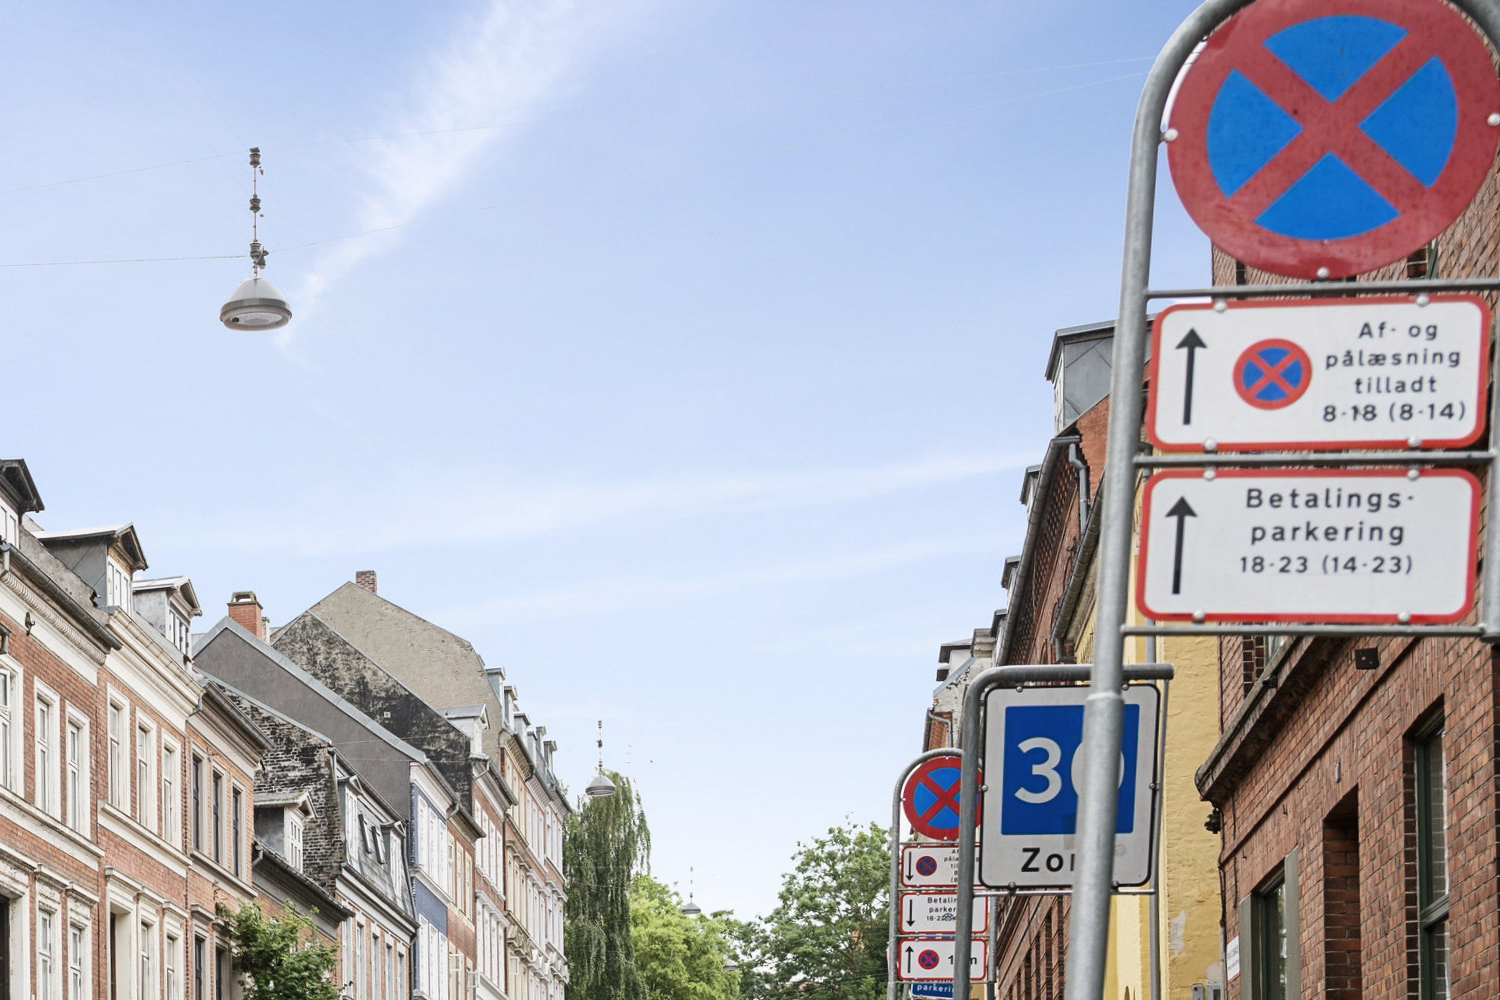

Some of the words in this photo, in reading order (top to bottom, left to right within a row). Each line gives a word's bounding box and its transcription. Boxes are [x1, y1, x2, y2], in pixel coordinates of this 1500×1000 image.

[1358, 321, 1397, 339] Af-
[1408, 323, 1438, 340] og
[1325, 349, 1461, 370] pålæsning
[1354, 376, 1437, 394] tilladt
[1322, 404, 1378, 422] 8-18
[1388, 401, 1466, 422] (8-14)
[1246, 488, 1414, 512] Betalings-
[1251, 522, 1405, 545] parkering
[1240, 556, 1308, 574] 18-23
[1322, 554, 1413, 575] (14-23)
[1021, 847, 1075, 872] Zo
